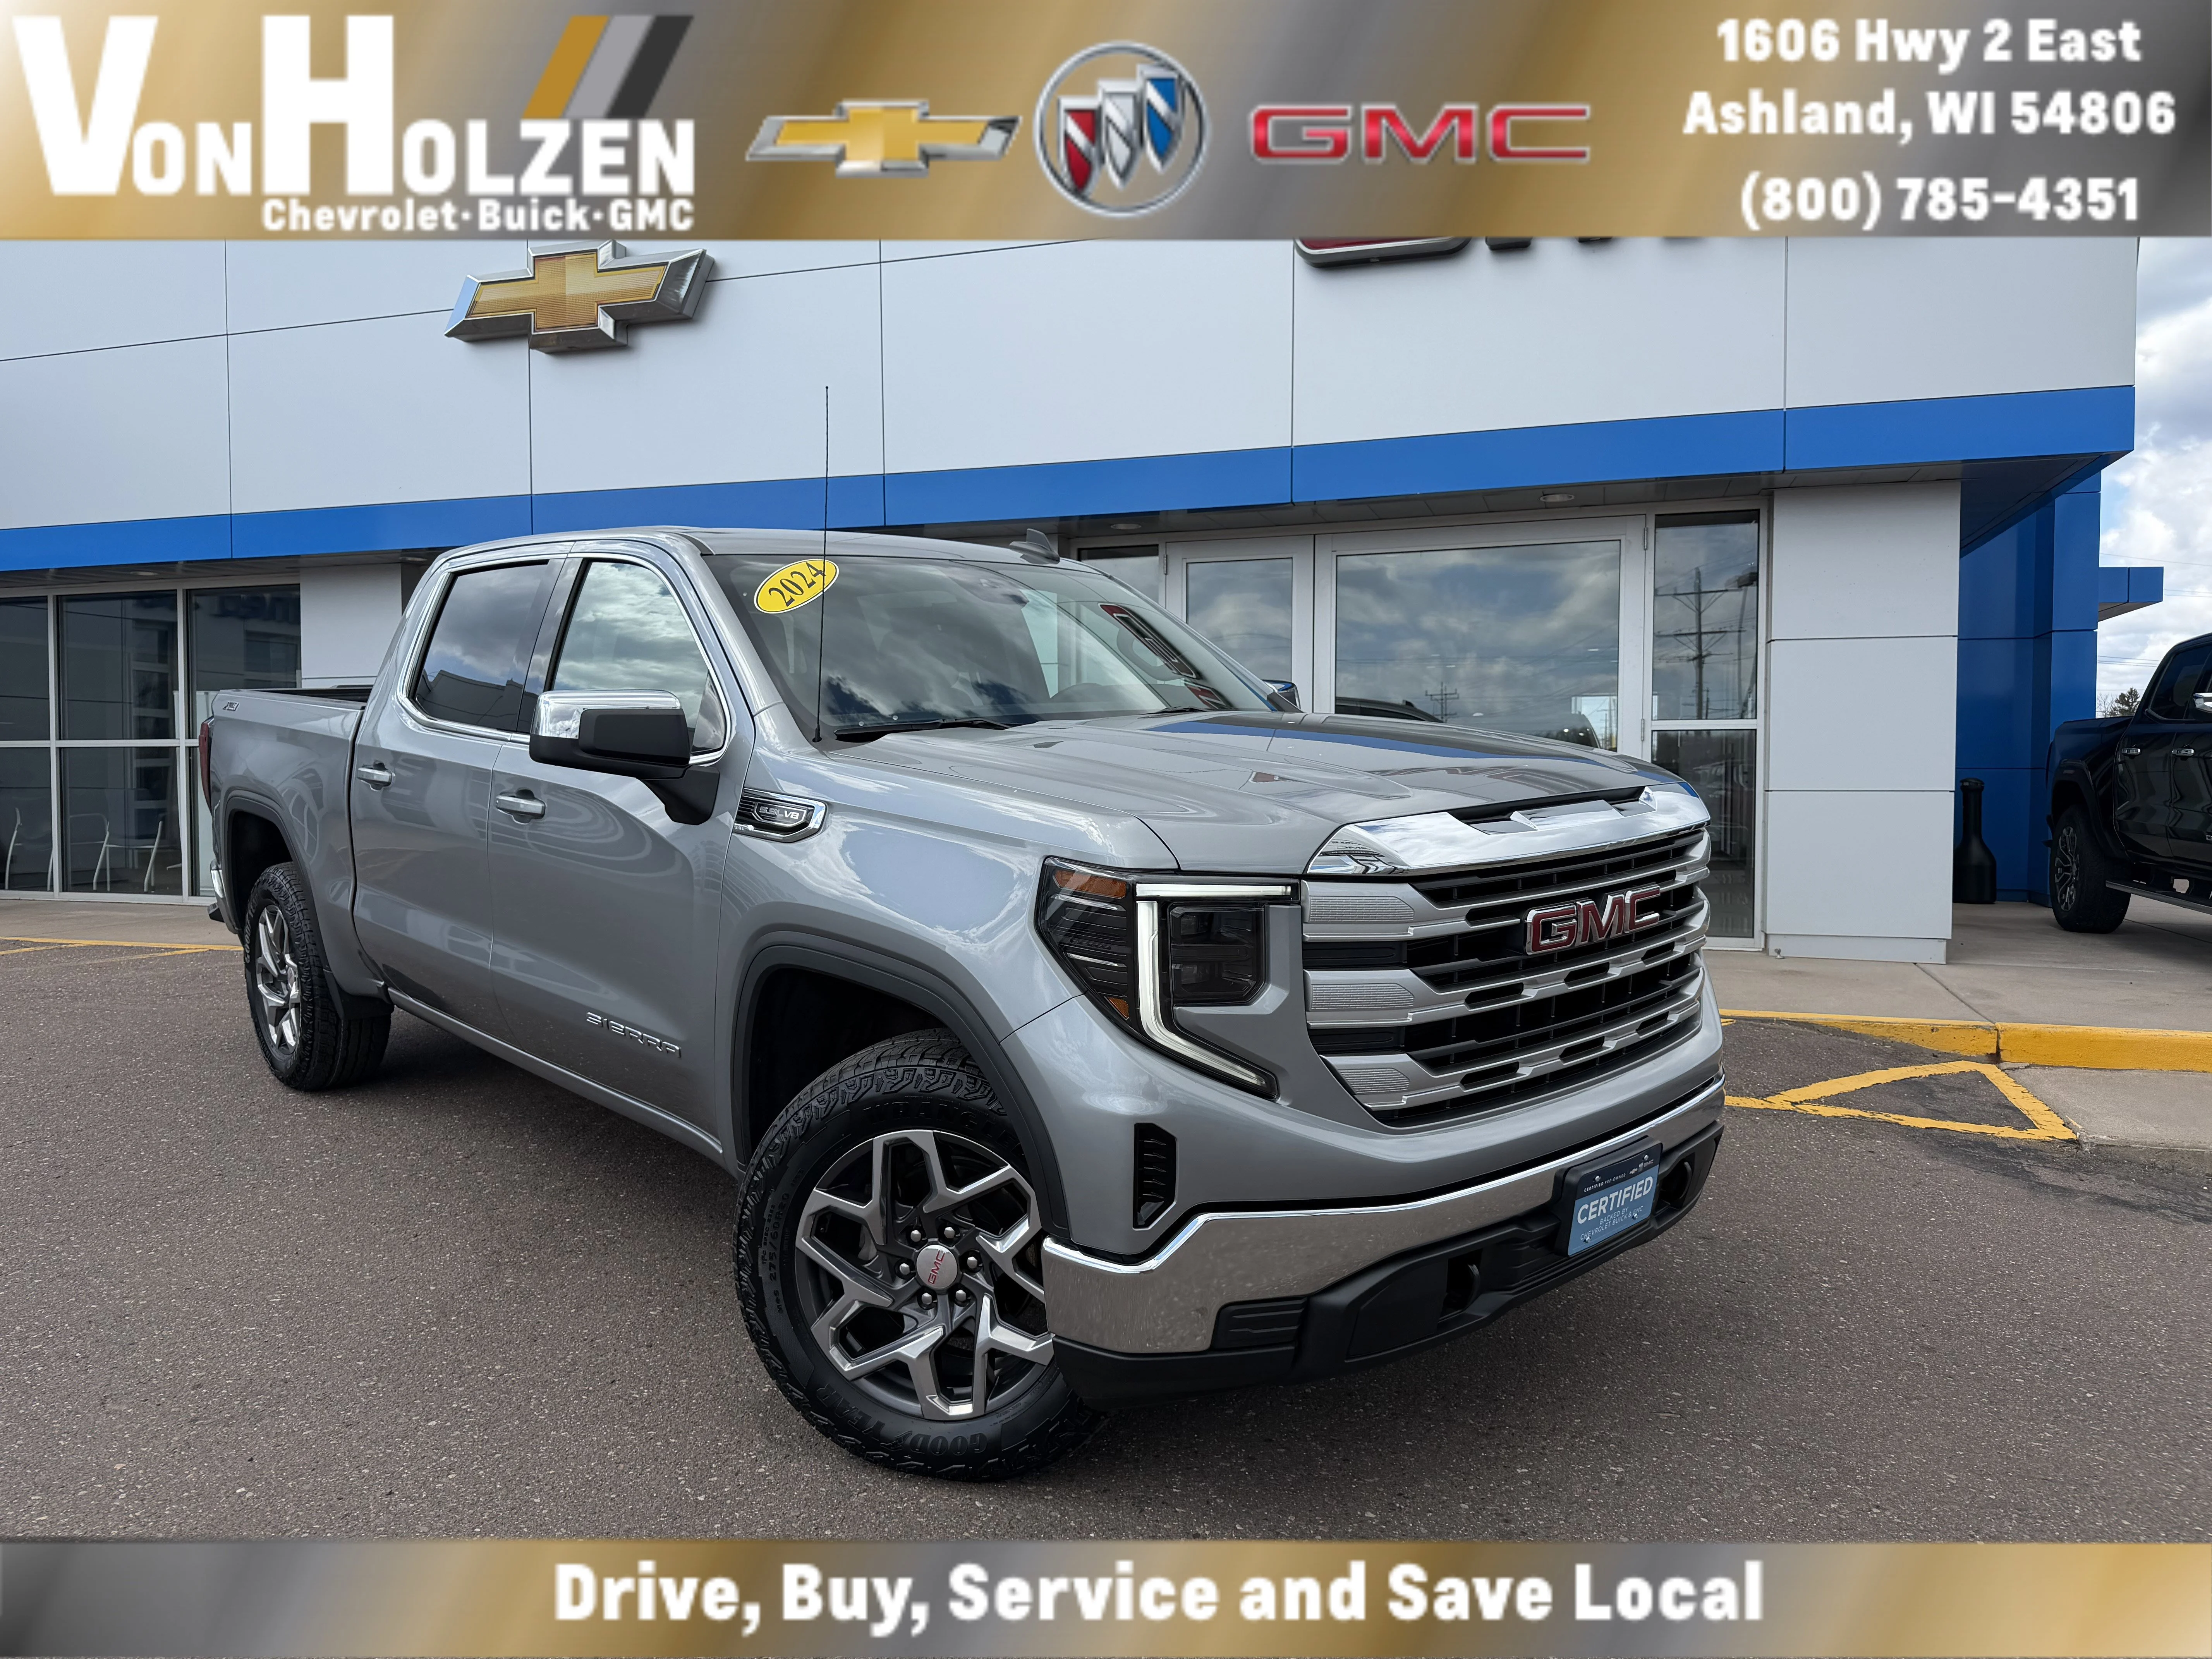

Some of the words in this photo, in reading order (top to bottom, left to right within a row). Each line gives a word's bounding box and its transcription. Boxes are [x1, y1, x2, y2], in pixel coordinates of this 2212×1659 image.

[768, 562, 826, 607] 2024
[784, 810, 800, 819] V8
[1525, 883, 1661, 955] GMC
[1577, 1176, 1653, 1224] CERTIFIED
[1583, 1182, 1604, 1193] CERTIFIED
[1580, 1221, 1611, 1240] CHEVROLET
[1612, 1214, 1628, 1225] BUICK
[1632, 1206, 1644, 1216] GMC
[1600, 1211, 1620, 1225] BACKED
[1622, 1206, 1629, 1214] BY
[769, 1193, 789, 1282] 275/60R20
[928, 1250, 945, 1285] GMC
